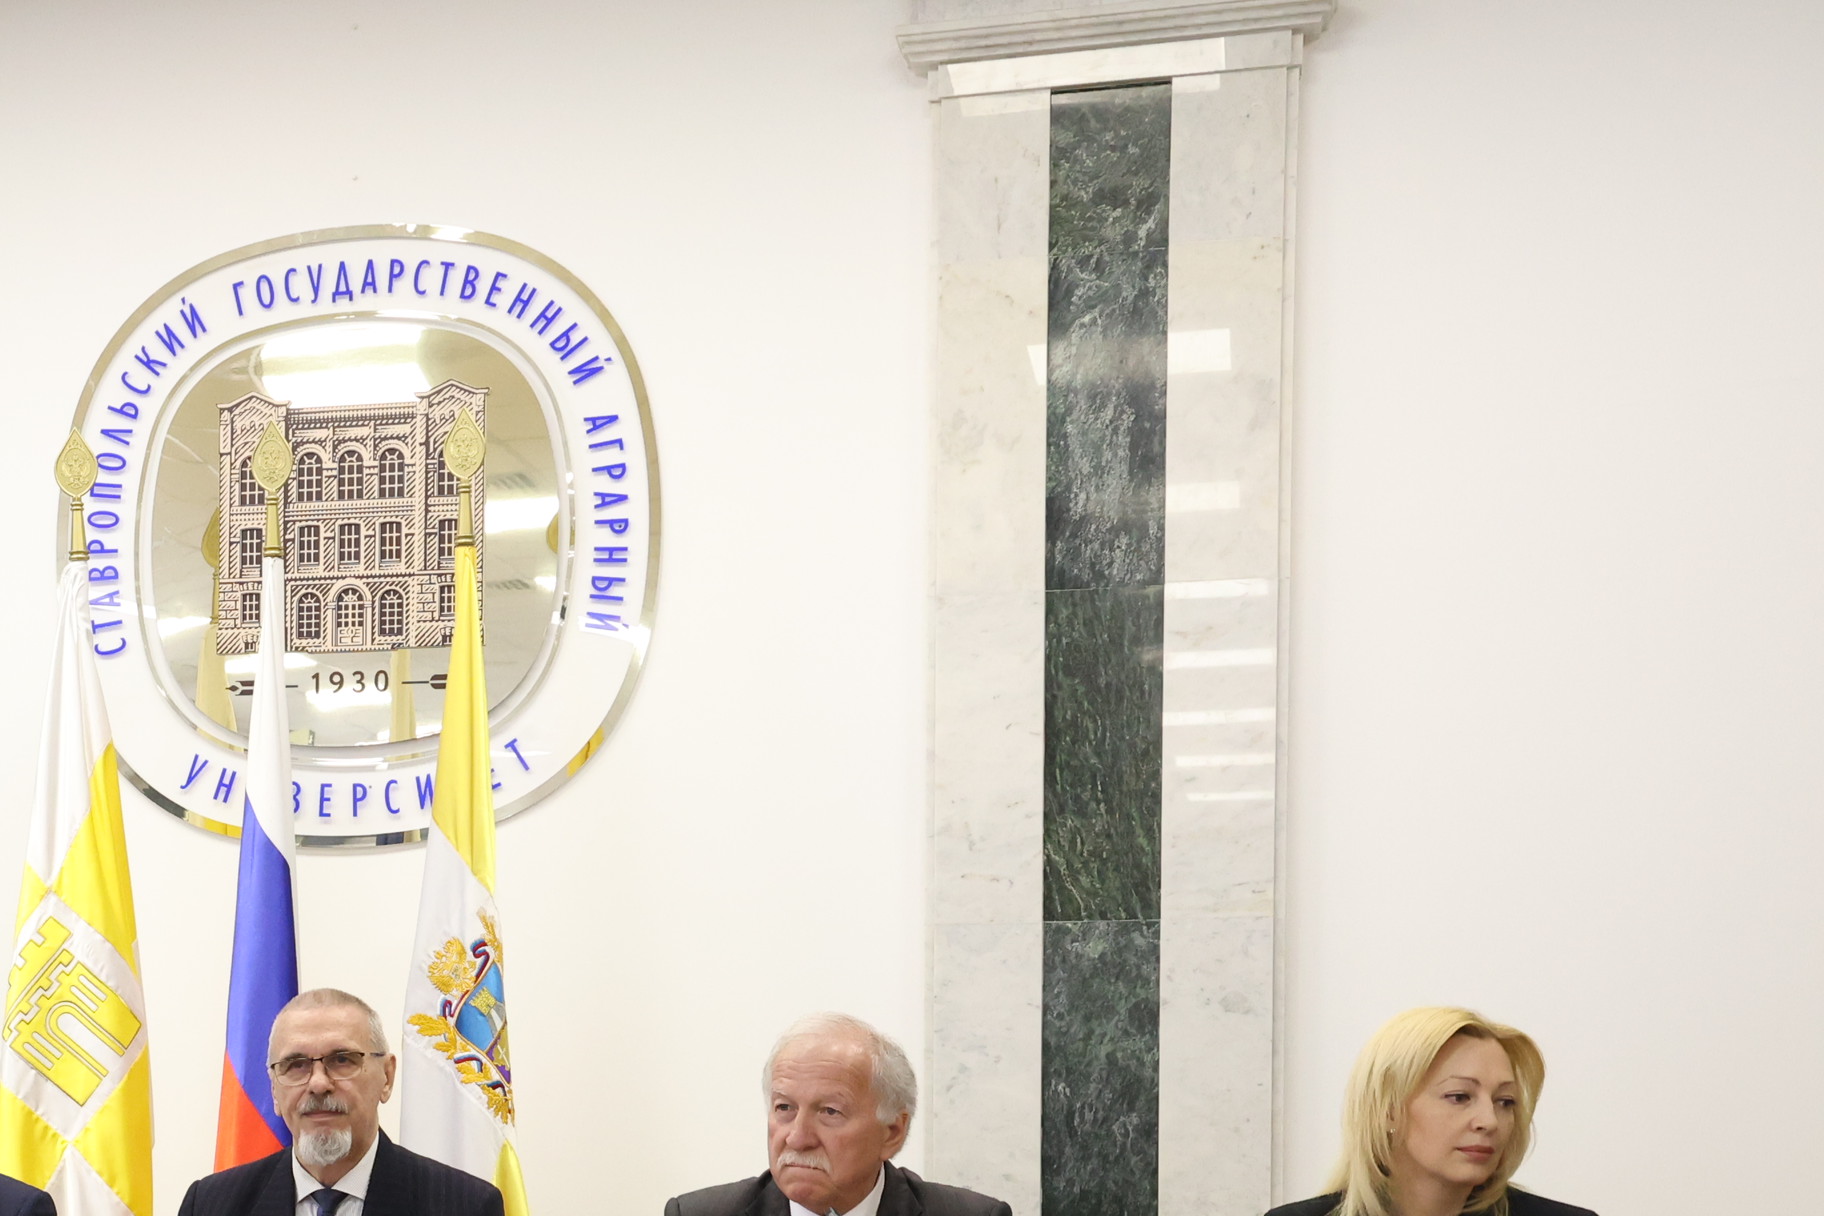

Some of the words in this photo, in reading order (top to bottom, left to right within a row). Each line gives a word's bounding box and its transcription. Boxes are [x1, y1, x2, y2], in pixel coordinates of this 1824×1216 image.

[87, 296, 207, 657] СТАВРОПОЛЬСКИЙ
[231, 258, 616, 386] ГОСУДАРСТВЕННЫЙ
[583, 414, 630, 633] АГРАРНЫЙ
[311, 670, 390, 694] 1930
